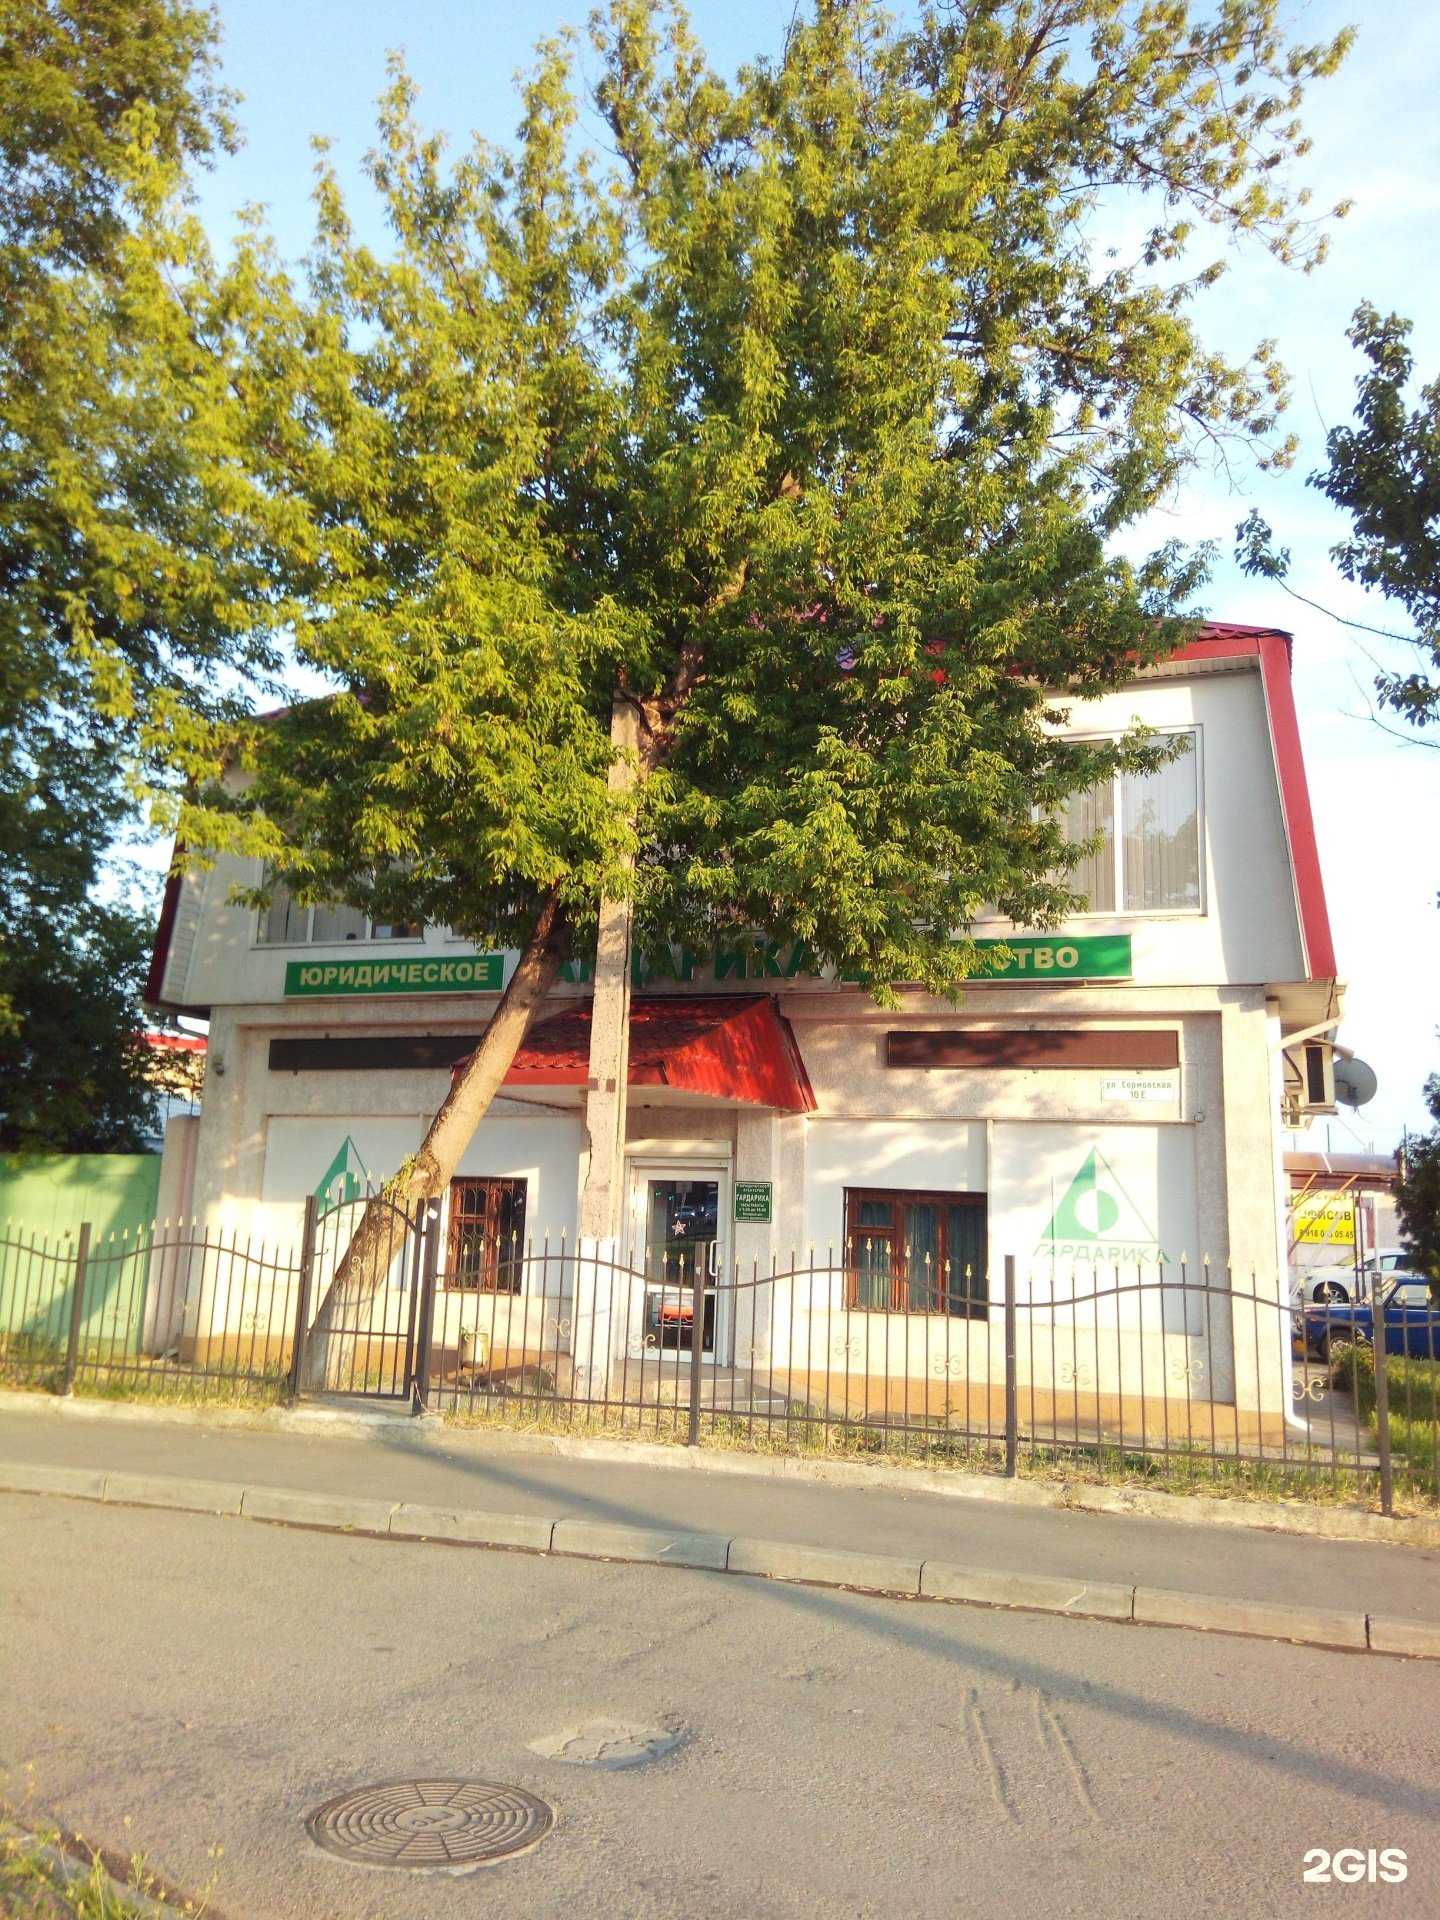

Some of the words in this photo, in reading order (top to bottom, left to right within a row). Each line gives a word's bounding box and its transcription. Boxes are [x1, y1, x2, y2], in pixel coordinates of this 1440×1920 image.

[299, 961, 490, 988] ЮРИДИЧЕСКОЕ
[736, 1193, 769, 1202] ГАРДАРИКА
[1032, 1243, 1171, 1264] ГАРДАРИКА
